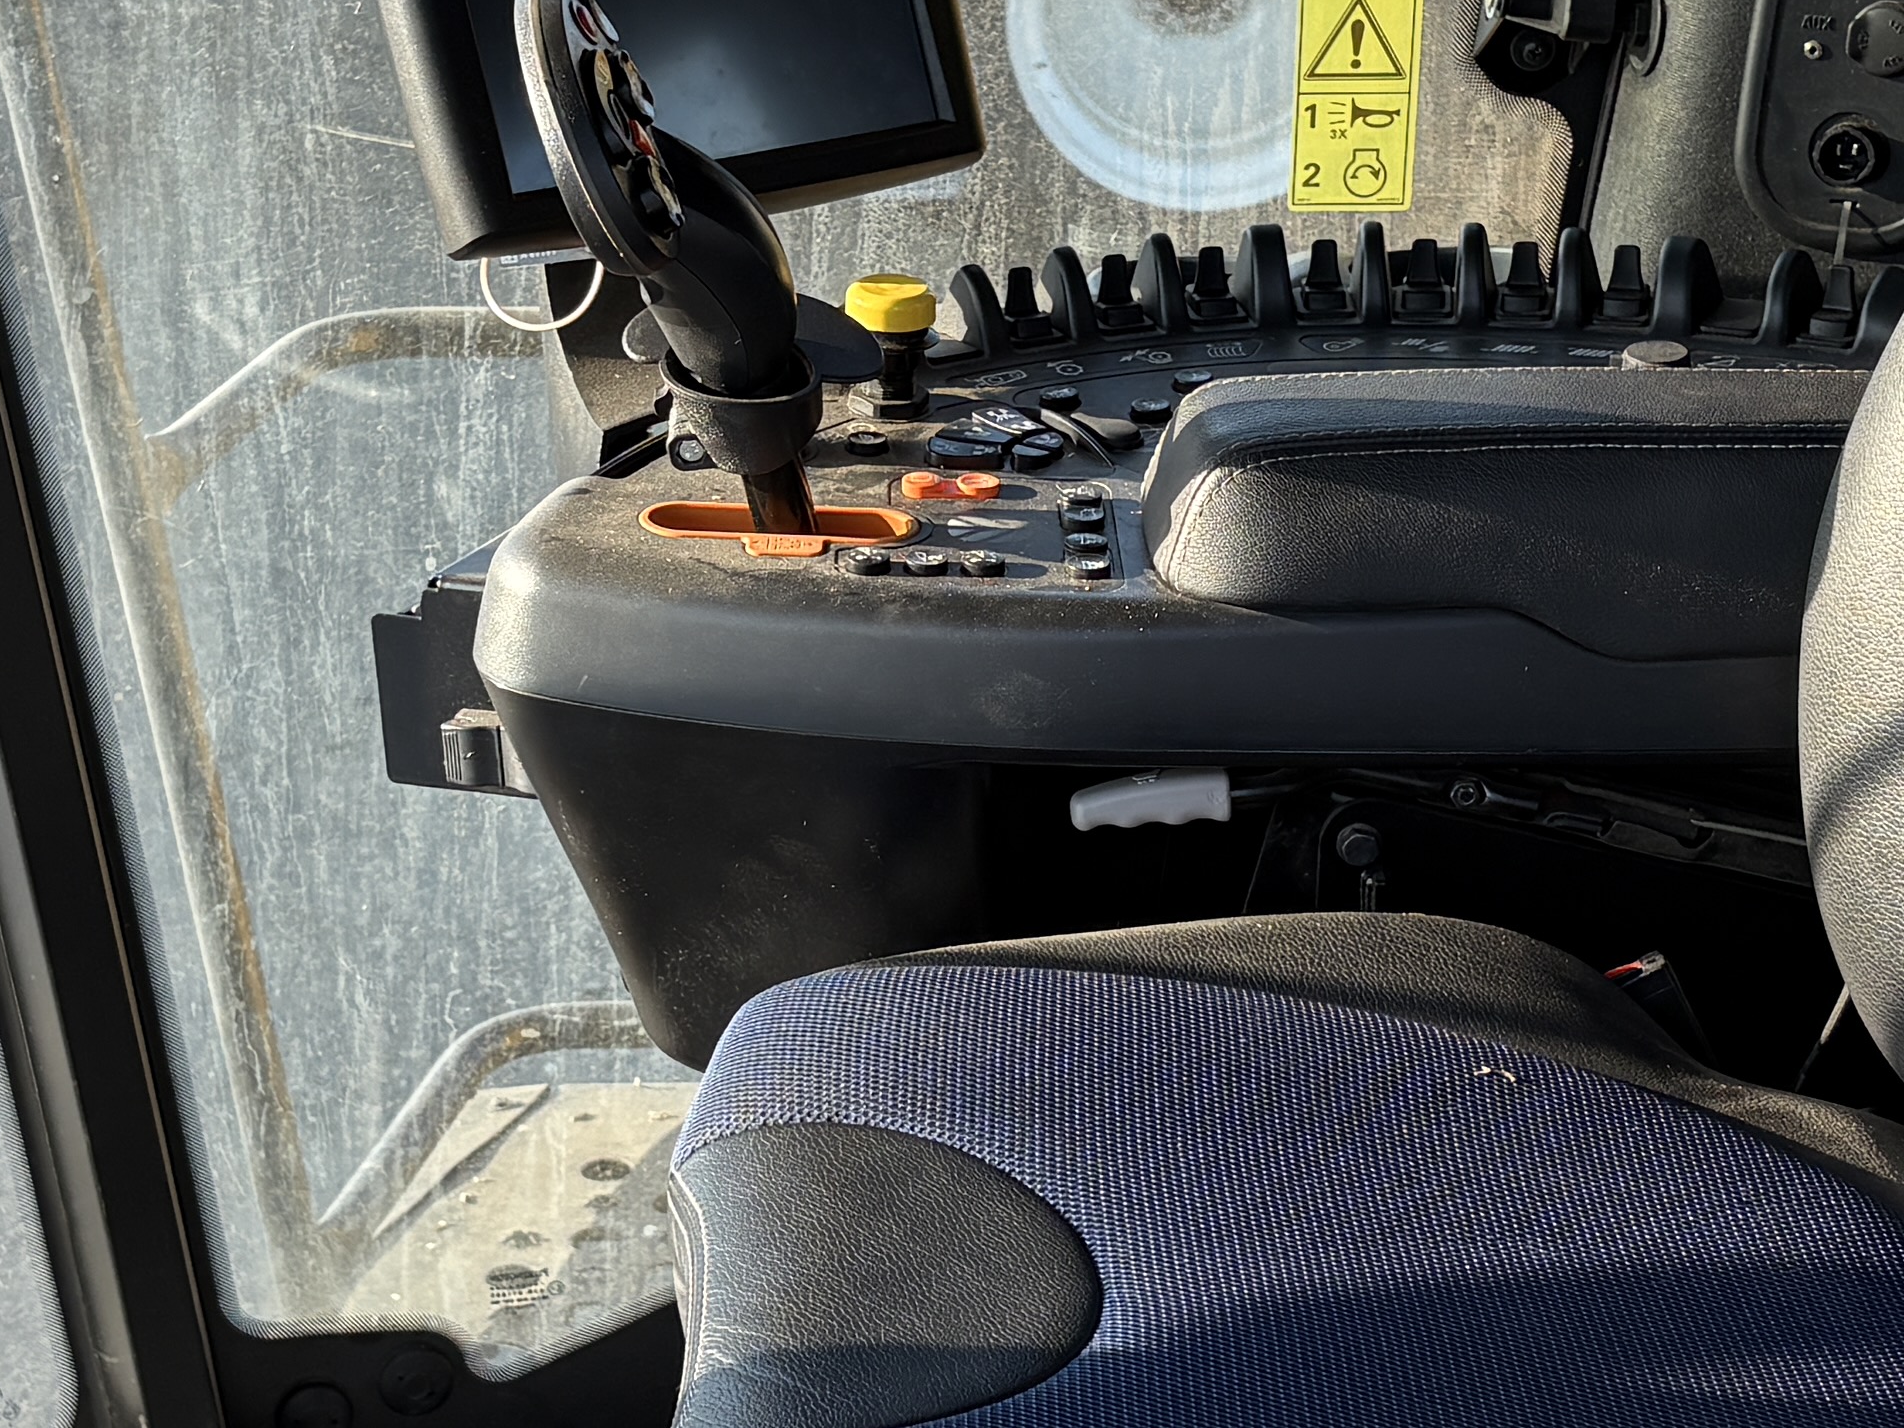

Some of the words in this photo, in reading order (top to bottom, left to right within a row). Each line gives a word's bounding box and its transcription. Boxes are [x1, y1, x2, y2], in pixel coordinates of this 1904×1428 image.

[1801, 14, 1833, 30] AUX
[1304, 104, 1317, 128] 1
[1329, 129, 1348, 140] 3X
[1302, 163, 1321, 187] 2
